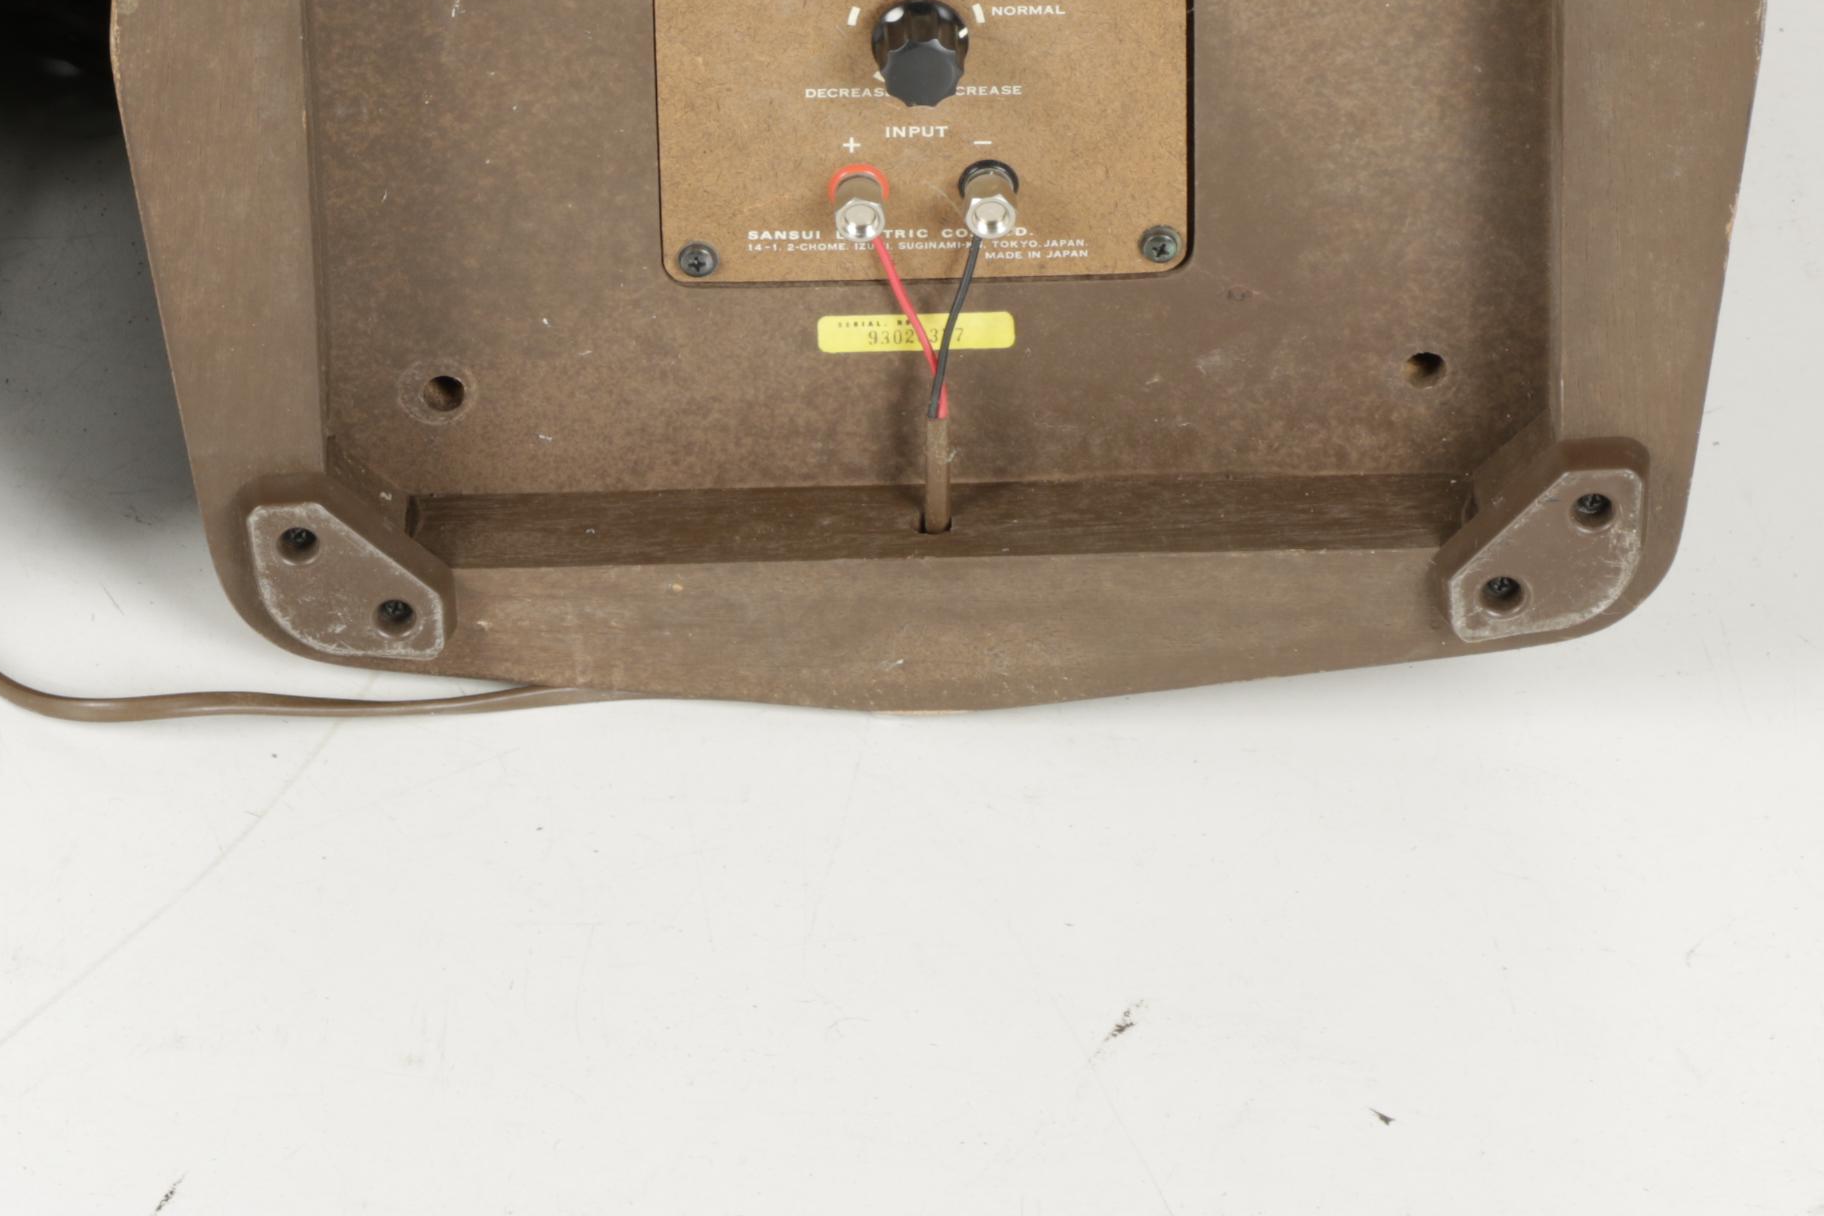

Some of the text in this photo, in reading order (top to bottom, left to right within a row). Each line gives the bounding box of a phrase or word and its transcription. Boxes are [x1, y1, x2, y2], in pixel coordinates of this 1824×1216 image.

[992, 5, 1065, 16] NORMAL
[956, 85, 1022, 96] CREASE
[885, 126, 948, 138] INPUT
[748, 230, 821, 240] SANSUI
[985, 251, 1024, 259] MADE
[1047, 250, 1088, 258] JAPAN
